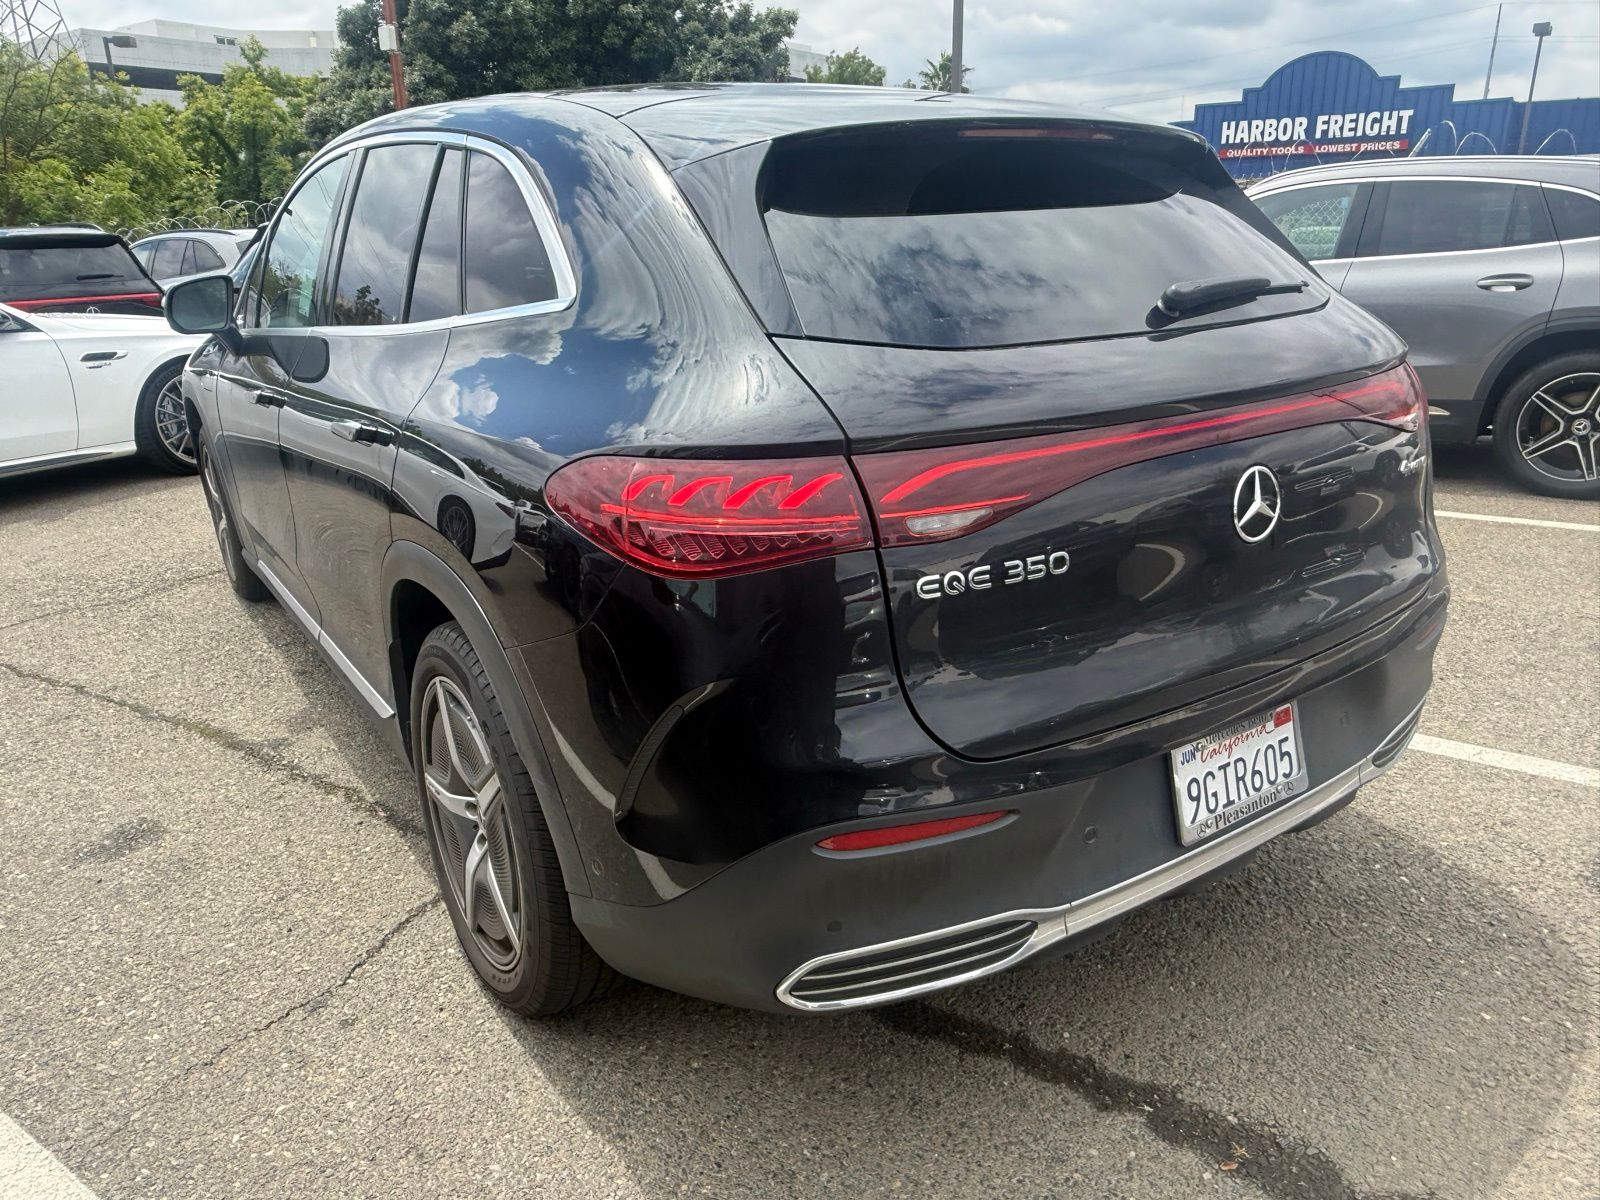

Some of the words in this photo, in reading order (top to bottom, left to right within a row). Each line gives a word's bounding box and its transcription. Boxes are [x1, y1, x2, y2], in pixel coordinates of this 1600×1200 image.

[1221, 116, 1308, 144] HARBOR
[1315, 109, 1414, 139] FREIGHT
[1226, 147, 1269, 158] QUALITY
[1271, 145, 1304, 154] TOOLS
[1314, 143, 1359, 153] LOWEST
[1360, 140, 1400, 151] PRICES
[916, 565, 992, 599] EQE
[1003, 551, 1070, 585] 350
[1180, 747, 1197, 766] JUN
[1200, 723, 1275, 763] California
[1186, 735, 1294, 825] 9GIR605
[1214, 791, 1279, 830] Pleasanton
